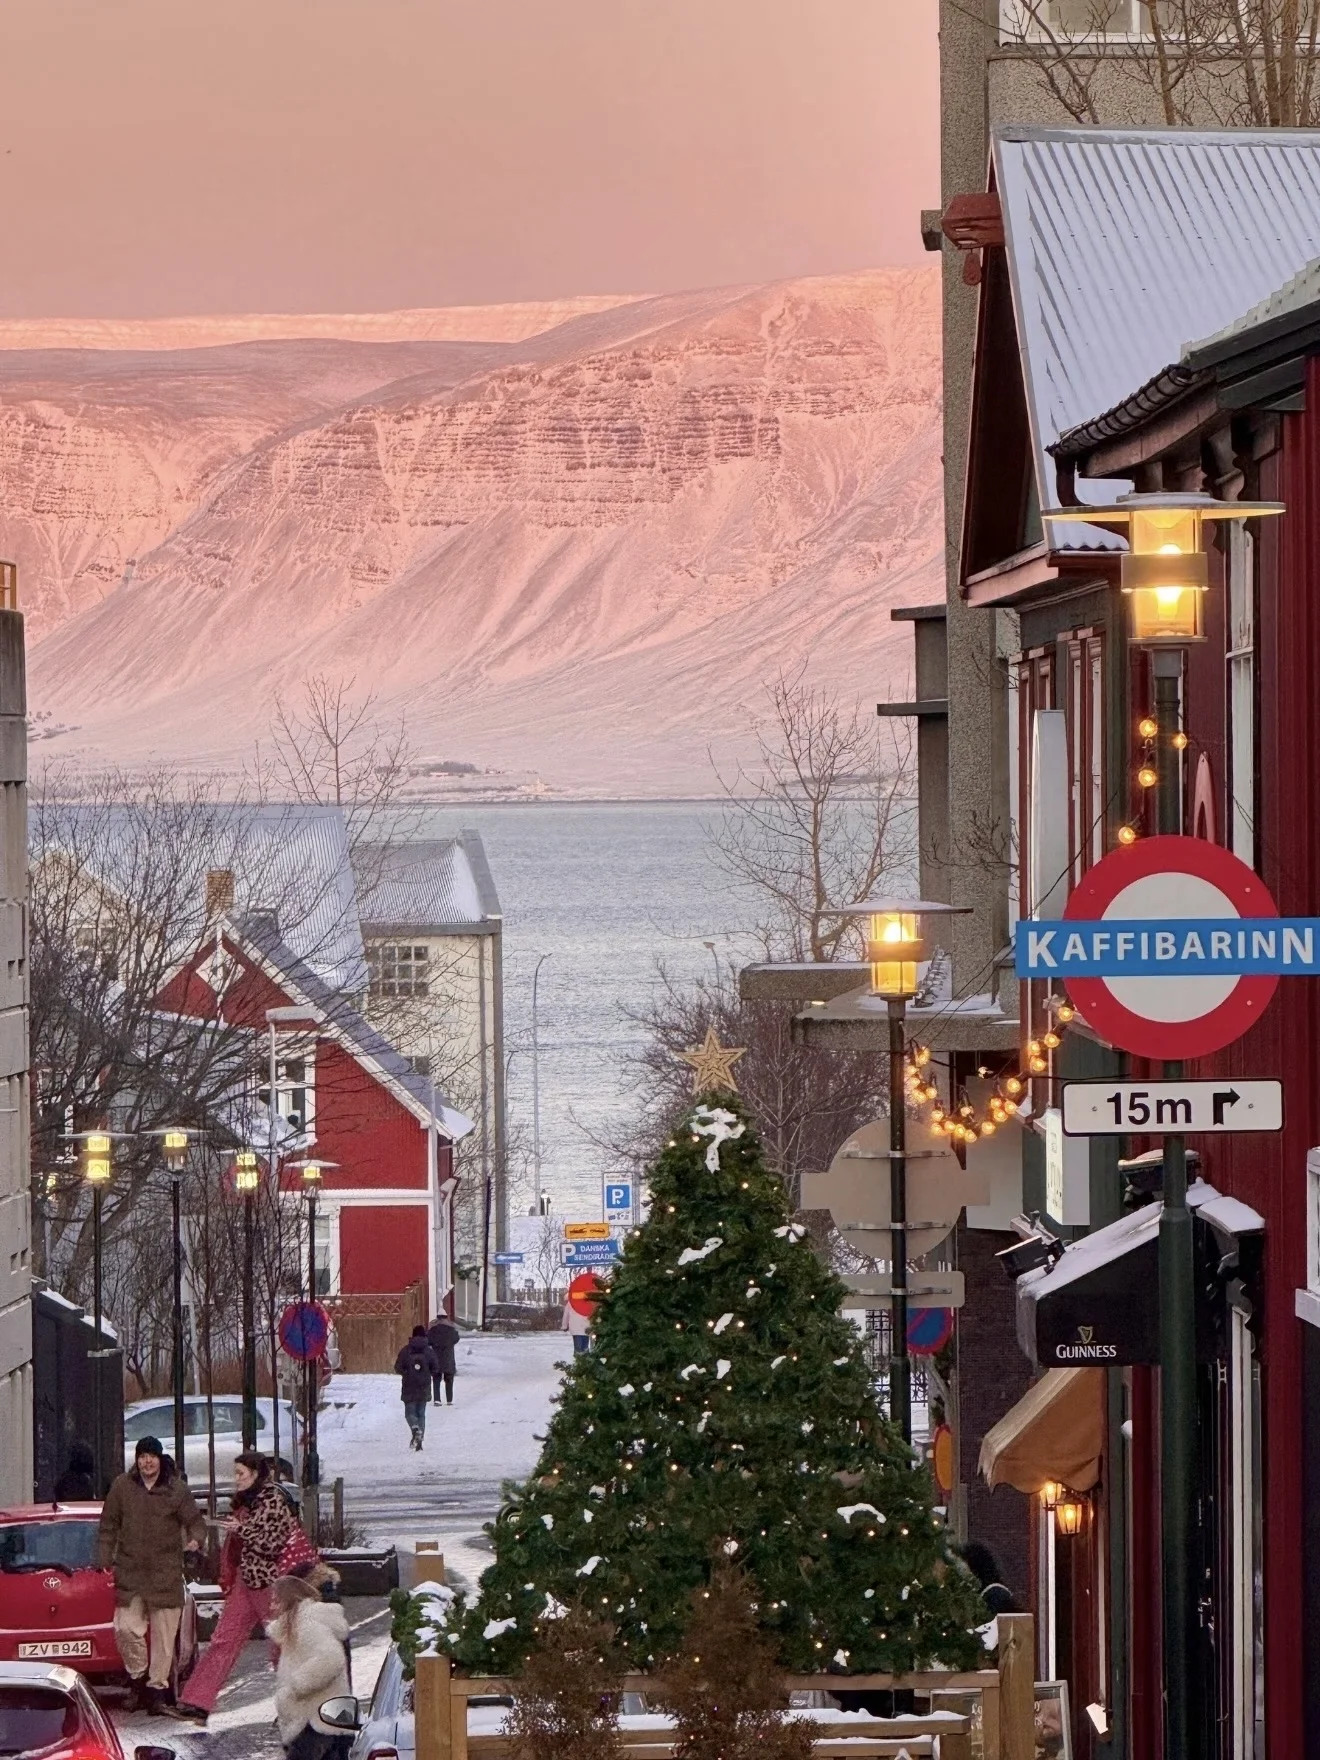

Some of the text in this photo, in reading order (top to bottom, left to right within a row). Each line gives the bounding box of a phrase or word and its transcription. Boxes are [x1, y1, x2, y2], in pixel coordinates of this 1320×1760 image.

[1028, 927, 1314, 968] KAFFIBARINN
[1106, 1091, 1192, 1125] 15m
[1056, 1344, 1117, 1358] GUINNESS
[28, 1642, 89, 1656] ZV 942
